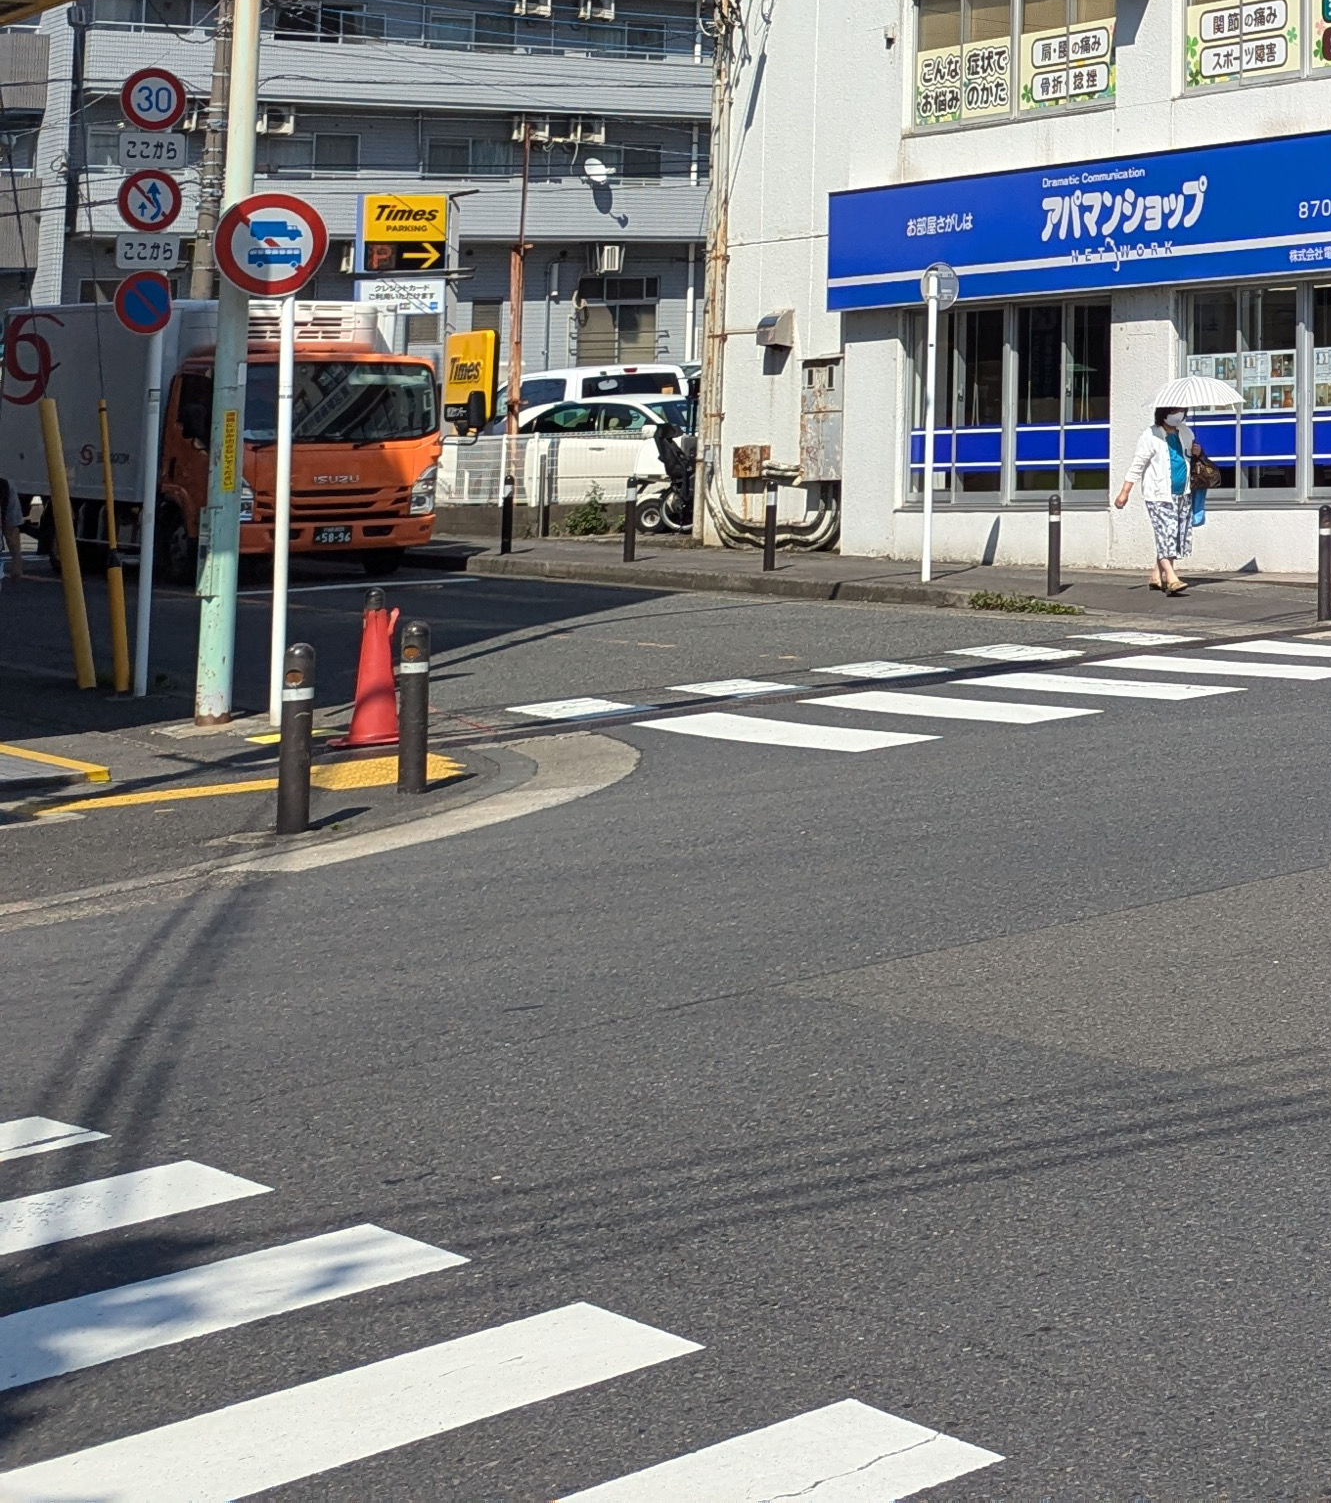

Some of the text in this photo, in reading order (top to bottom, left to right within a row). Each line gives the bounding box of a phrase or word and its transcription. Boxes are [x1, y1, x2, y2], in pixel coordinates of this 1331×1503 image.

[1213, 5, 1277, 34] 関節の痛み
[922, 49, 1009, 84] こんな症状で
[1212, 43, 1277, 71] スポーツ障害
[136, 85, 173, 114] 30
[922, 83, 1008, 113] お悩みのかた
[126, 141, 177, 160] ここから
[1042, 166, 1145, 189] Dramatic Communication
[375, 204, 439, 222] Times
[1041, 175, 1208, 242] アパマンショップ
[906, 214, 974, 237] お部屋さがしは
[123, 242, 174, 261] ここから
[449, 356, 482, 382] Times
[313, 474, 360, 484] ISUZU
